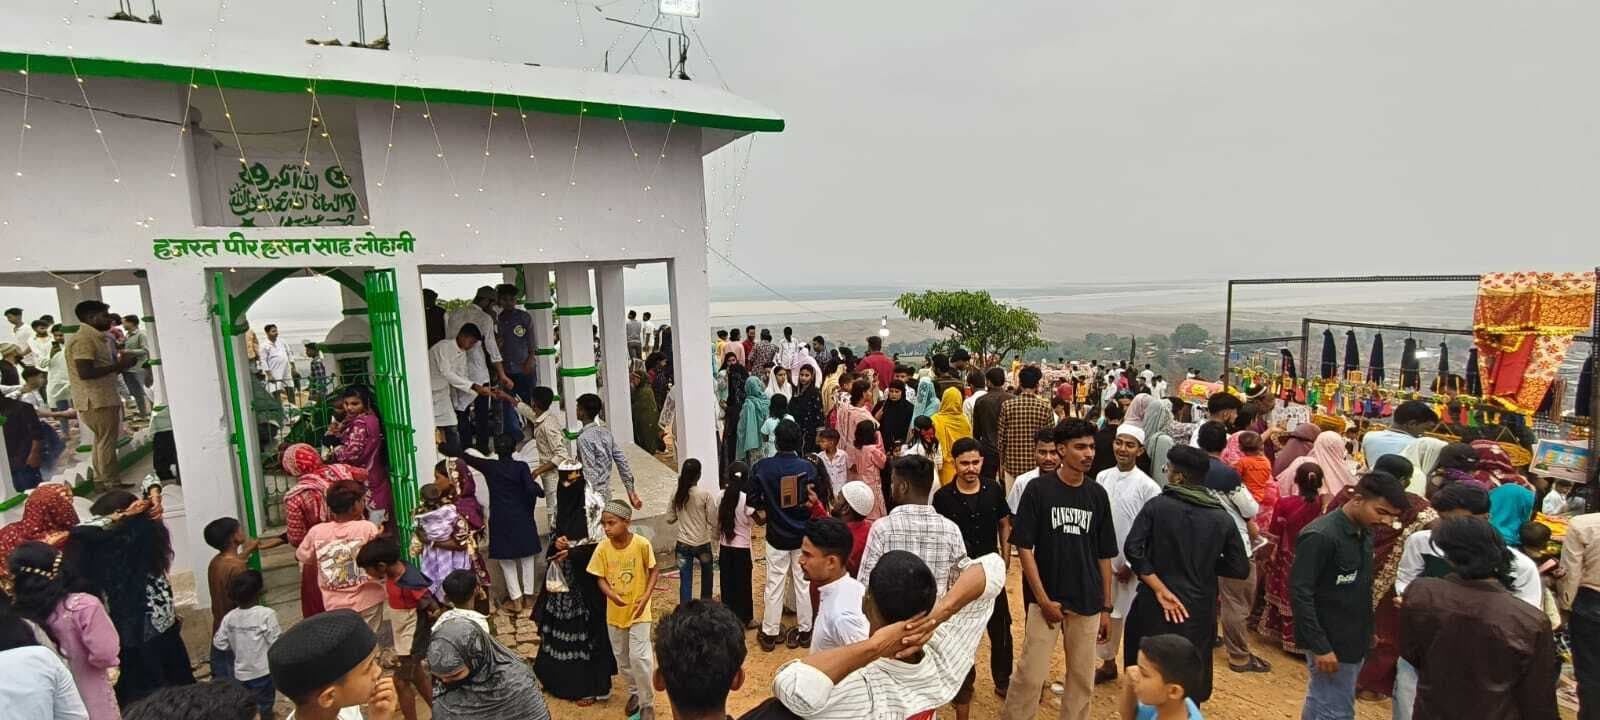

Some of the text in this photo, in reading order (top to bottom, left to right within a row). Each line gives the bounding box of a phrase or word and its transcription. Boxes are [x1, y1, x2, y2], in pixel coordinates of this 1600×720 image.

[223, 231, 260, 258] पीर
[311, 238, 353, 257] साह
[353, 231, 417, 255] लोहानी
